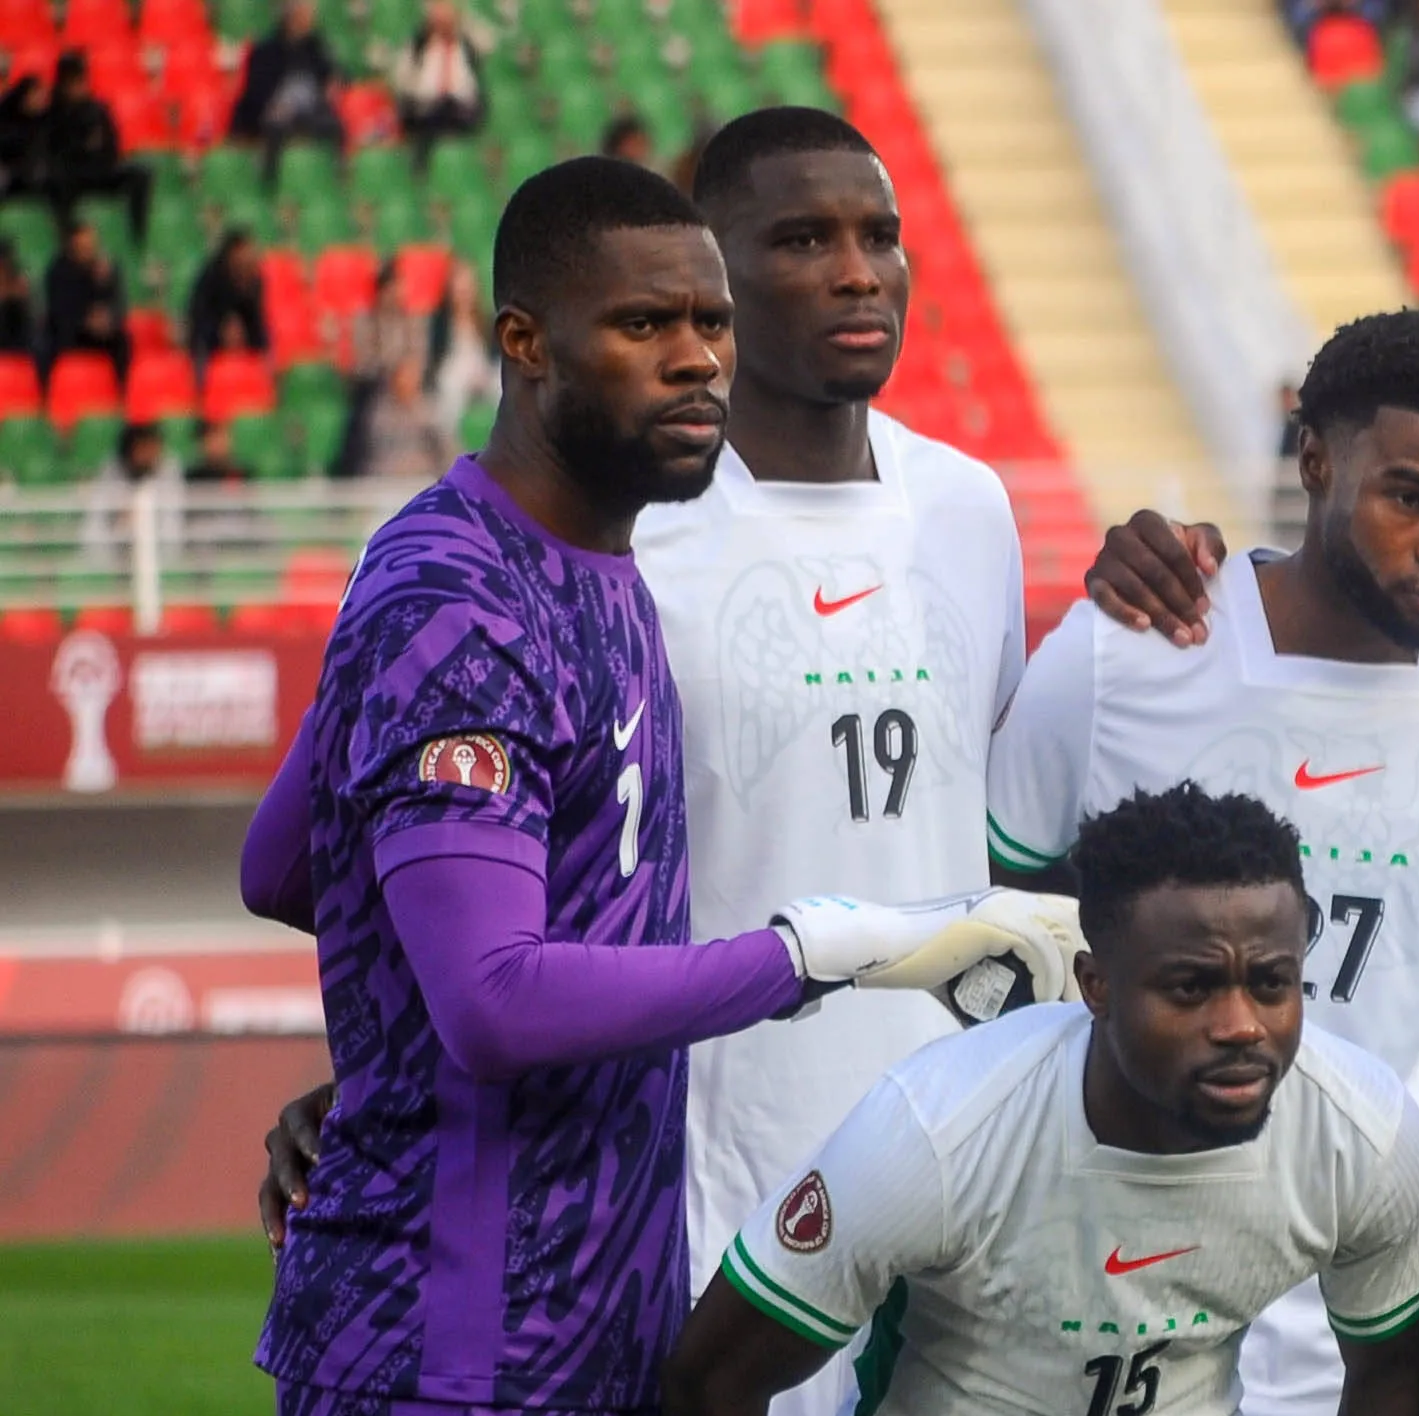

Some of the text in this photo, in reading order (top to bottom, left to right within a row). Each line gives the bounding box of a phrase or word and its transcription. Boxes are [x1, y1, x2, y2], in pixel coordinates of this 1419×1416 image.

[804, 668, 931, 685] NAIJA
[831, 708, 918, 823] 19
[617, 762, 643, 878] 1
[1298, 844, 1408, 866] AIJA
[1061, 1312, 1208, 1335] NAIJA
